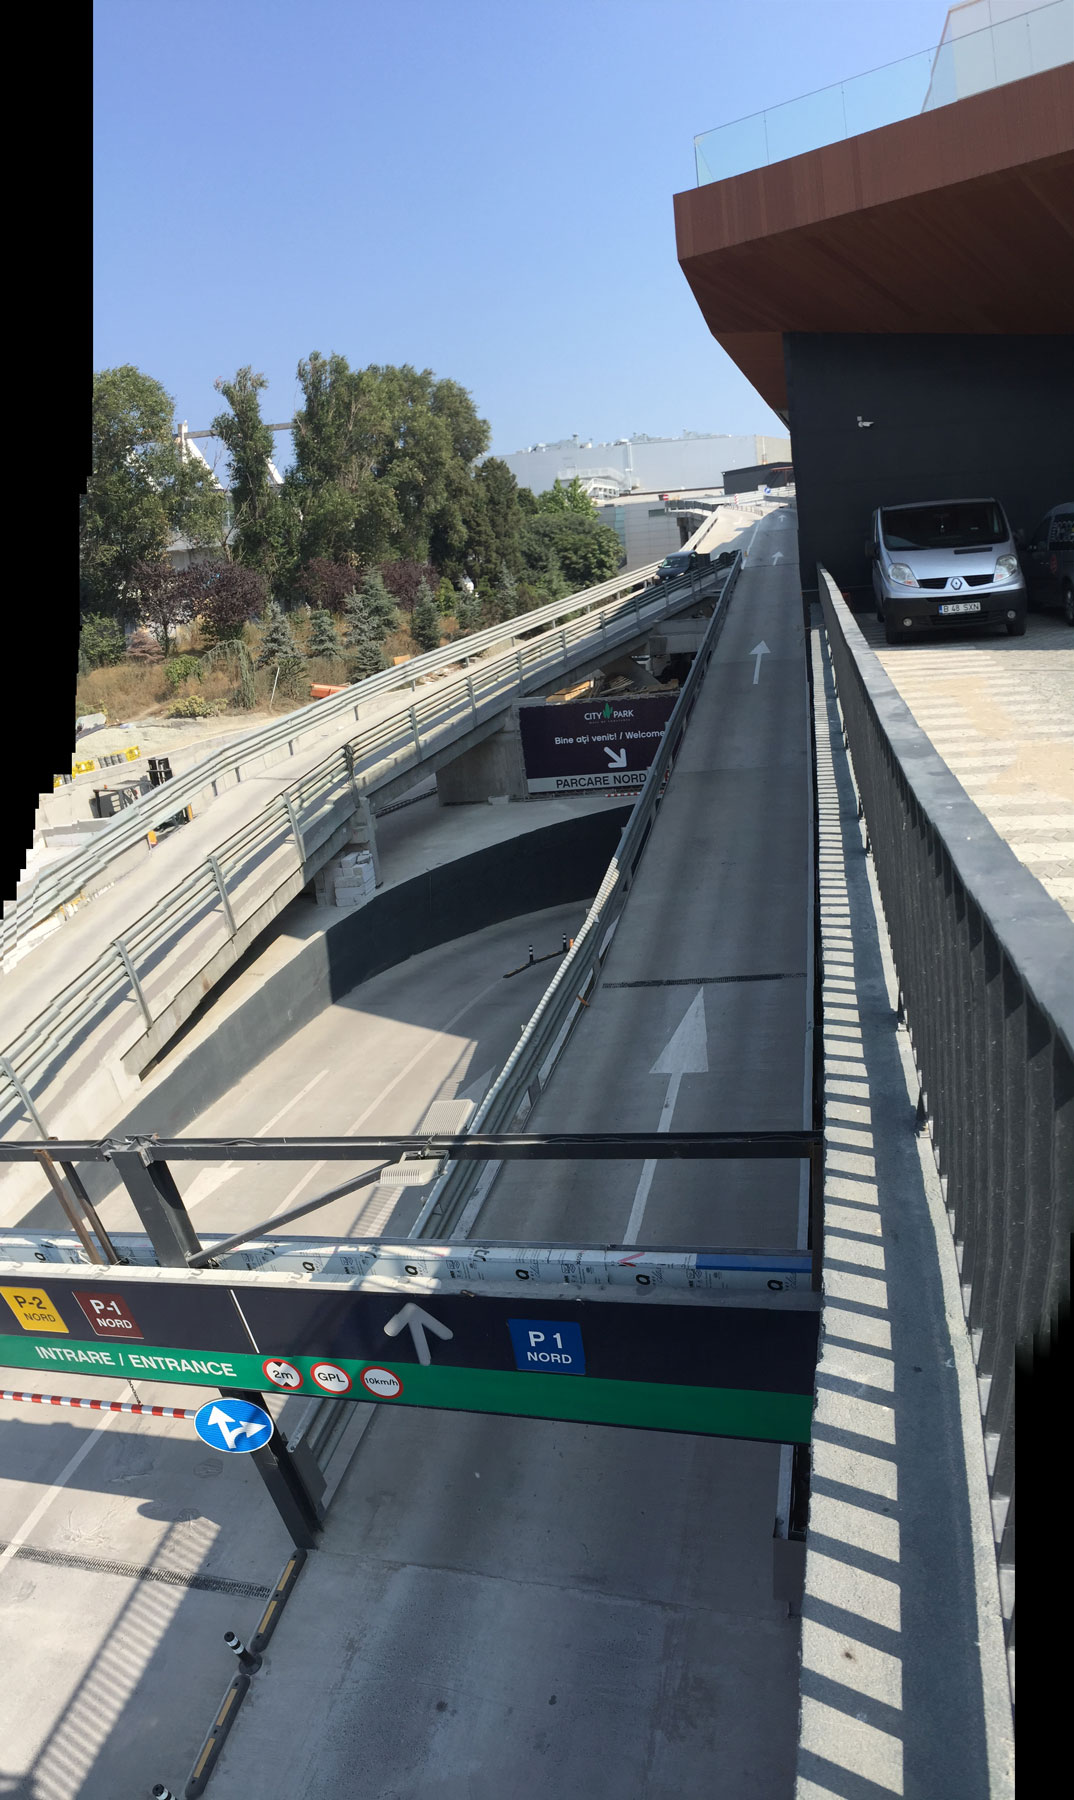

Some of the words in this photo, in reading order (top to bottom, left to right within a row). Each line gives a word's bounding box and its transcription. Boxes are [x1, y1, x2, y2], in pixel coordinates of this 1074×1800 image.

[963, 603, 979, 611] SXN
[584, 712, 602, 720] CITY
[613, 710, 634, 718] PARK
[554, 736, 574, 745] Bine
[592, 733, 617, 742] venit!
[556, 776, 610, 788] PARCARE
[613, 773, 647, 785] NORD
[13, 1295, 47, 1310] P-2
[89, 1298, 122, 1316] P-1
[23, 1312, 56, 1323] NORD
[96, 1317, 133, 1330] NORD
[528, 1330, 545, 1347] P
[553, 1332, 563, 1349] 1
[34, 1346, 116, 1366] INTRARE
[119, 1352, 124, 1366] /
[128, 1354, 238, 1377] ENTRANCE
[527, 1351, 572, 1364] NORD
[272, 1369, 294, 1380] 2m
[318, 1372, 346, 1383] GPL
[365, 1377, 399, 1387] 10km/h
